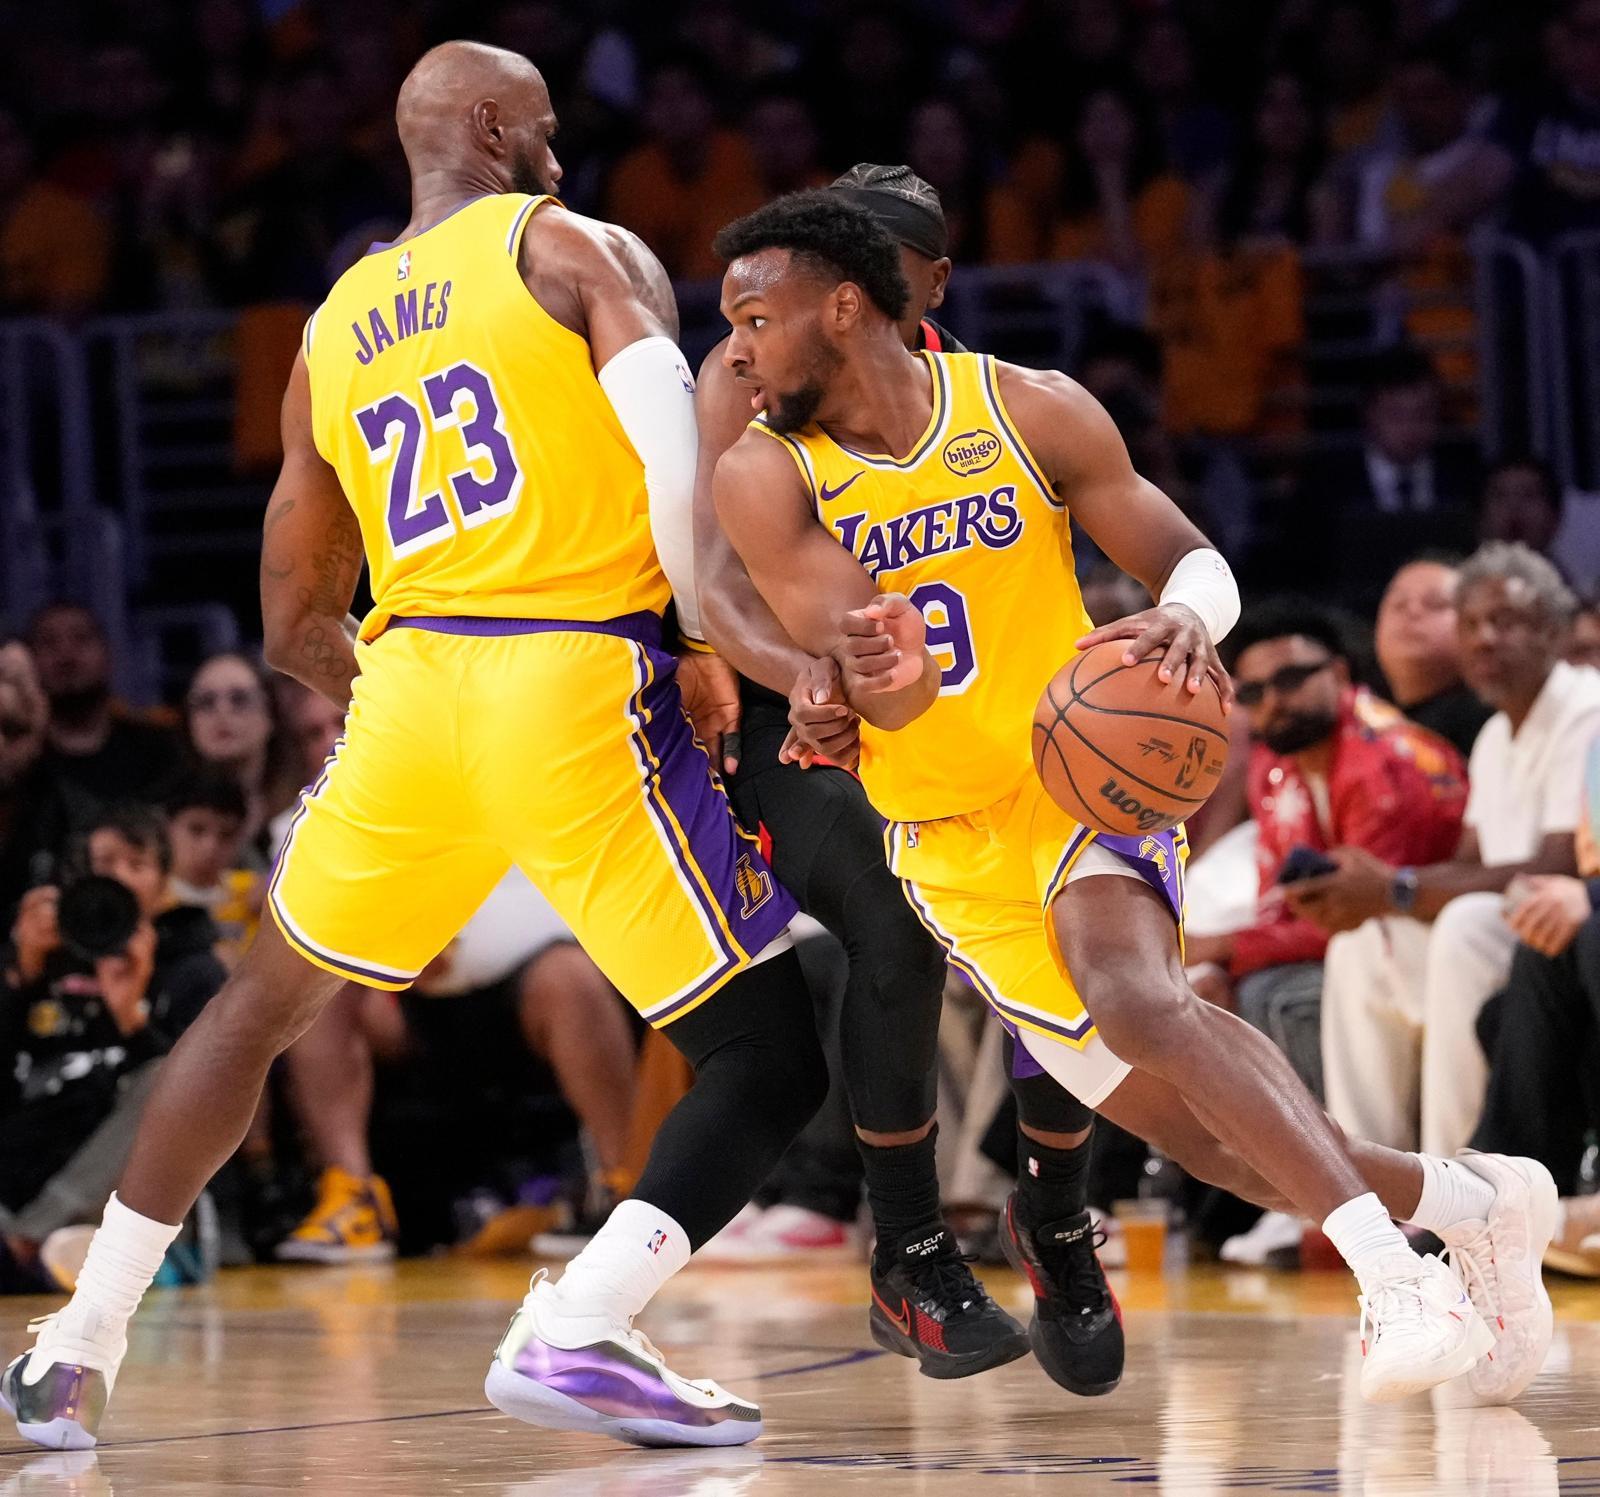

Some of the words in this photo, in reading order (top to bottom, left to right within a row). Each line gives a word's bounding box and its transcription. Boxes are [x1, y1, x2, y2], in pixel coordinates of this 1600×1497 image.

[351, 280, 452, 366] JAMES
[352, 359, 525, 561] 23
[947, 440, 997, 464] bibigo
[960, 456, 981, 468] 비비고
[906, 580, 980, 696] 9
[920, 1244, 939, 1256] 4TH
[923, 1232, 944, 1247] CUT
